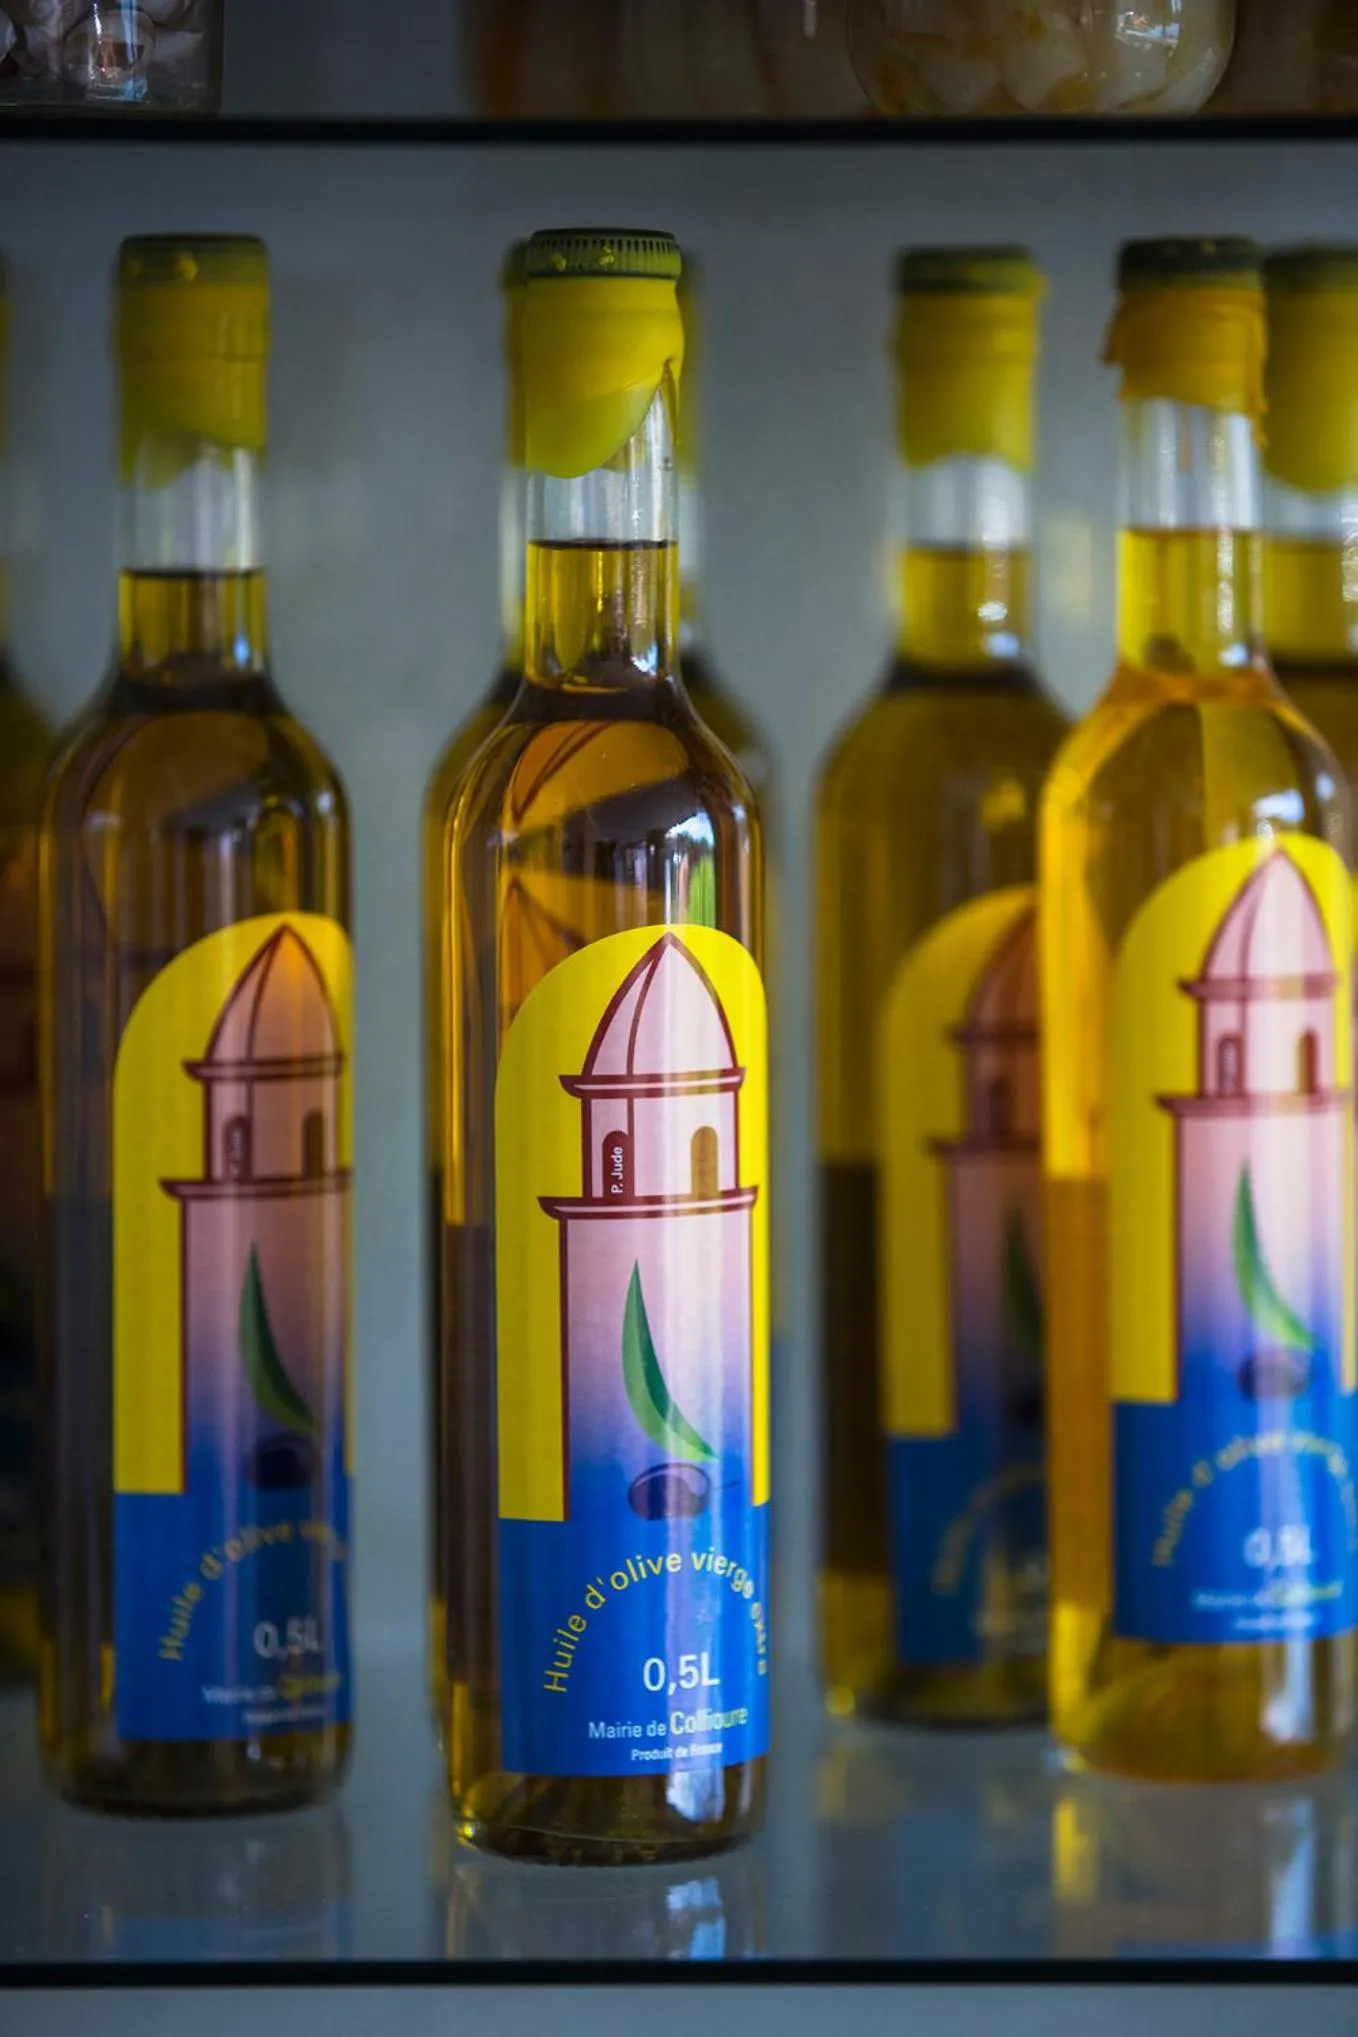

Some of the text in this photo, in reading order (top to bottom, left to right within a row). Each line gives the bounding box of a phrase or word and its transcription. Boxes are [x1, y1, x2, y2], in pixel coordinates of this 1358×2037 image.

[610, 1146, 623, 1194] P. Jude
[544, 1614, 587, 1693] Huile
[585, 1552, 682, 1610] d'olive
[691, 1547, 755, 1600] vierge
[643, 1651, 720, 1696] 0,5L
[588, 1707, 748, 1739] Mairie de Collioure
[631, 1748, 673, 1760] Produit
